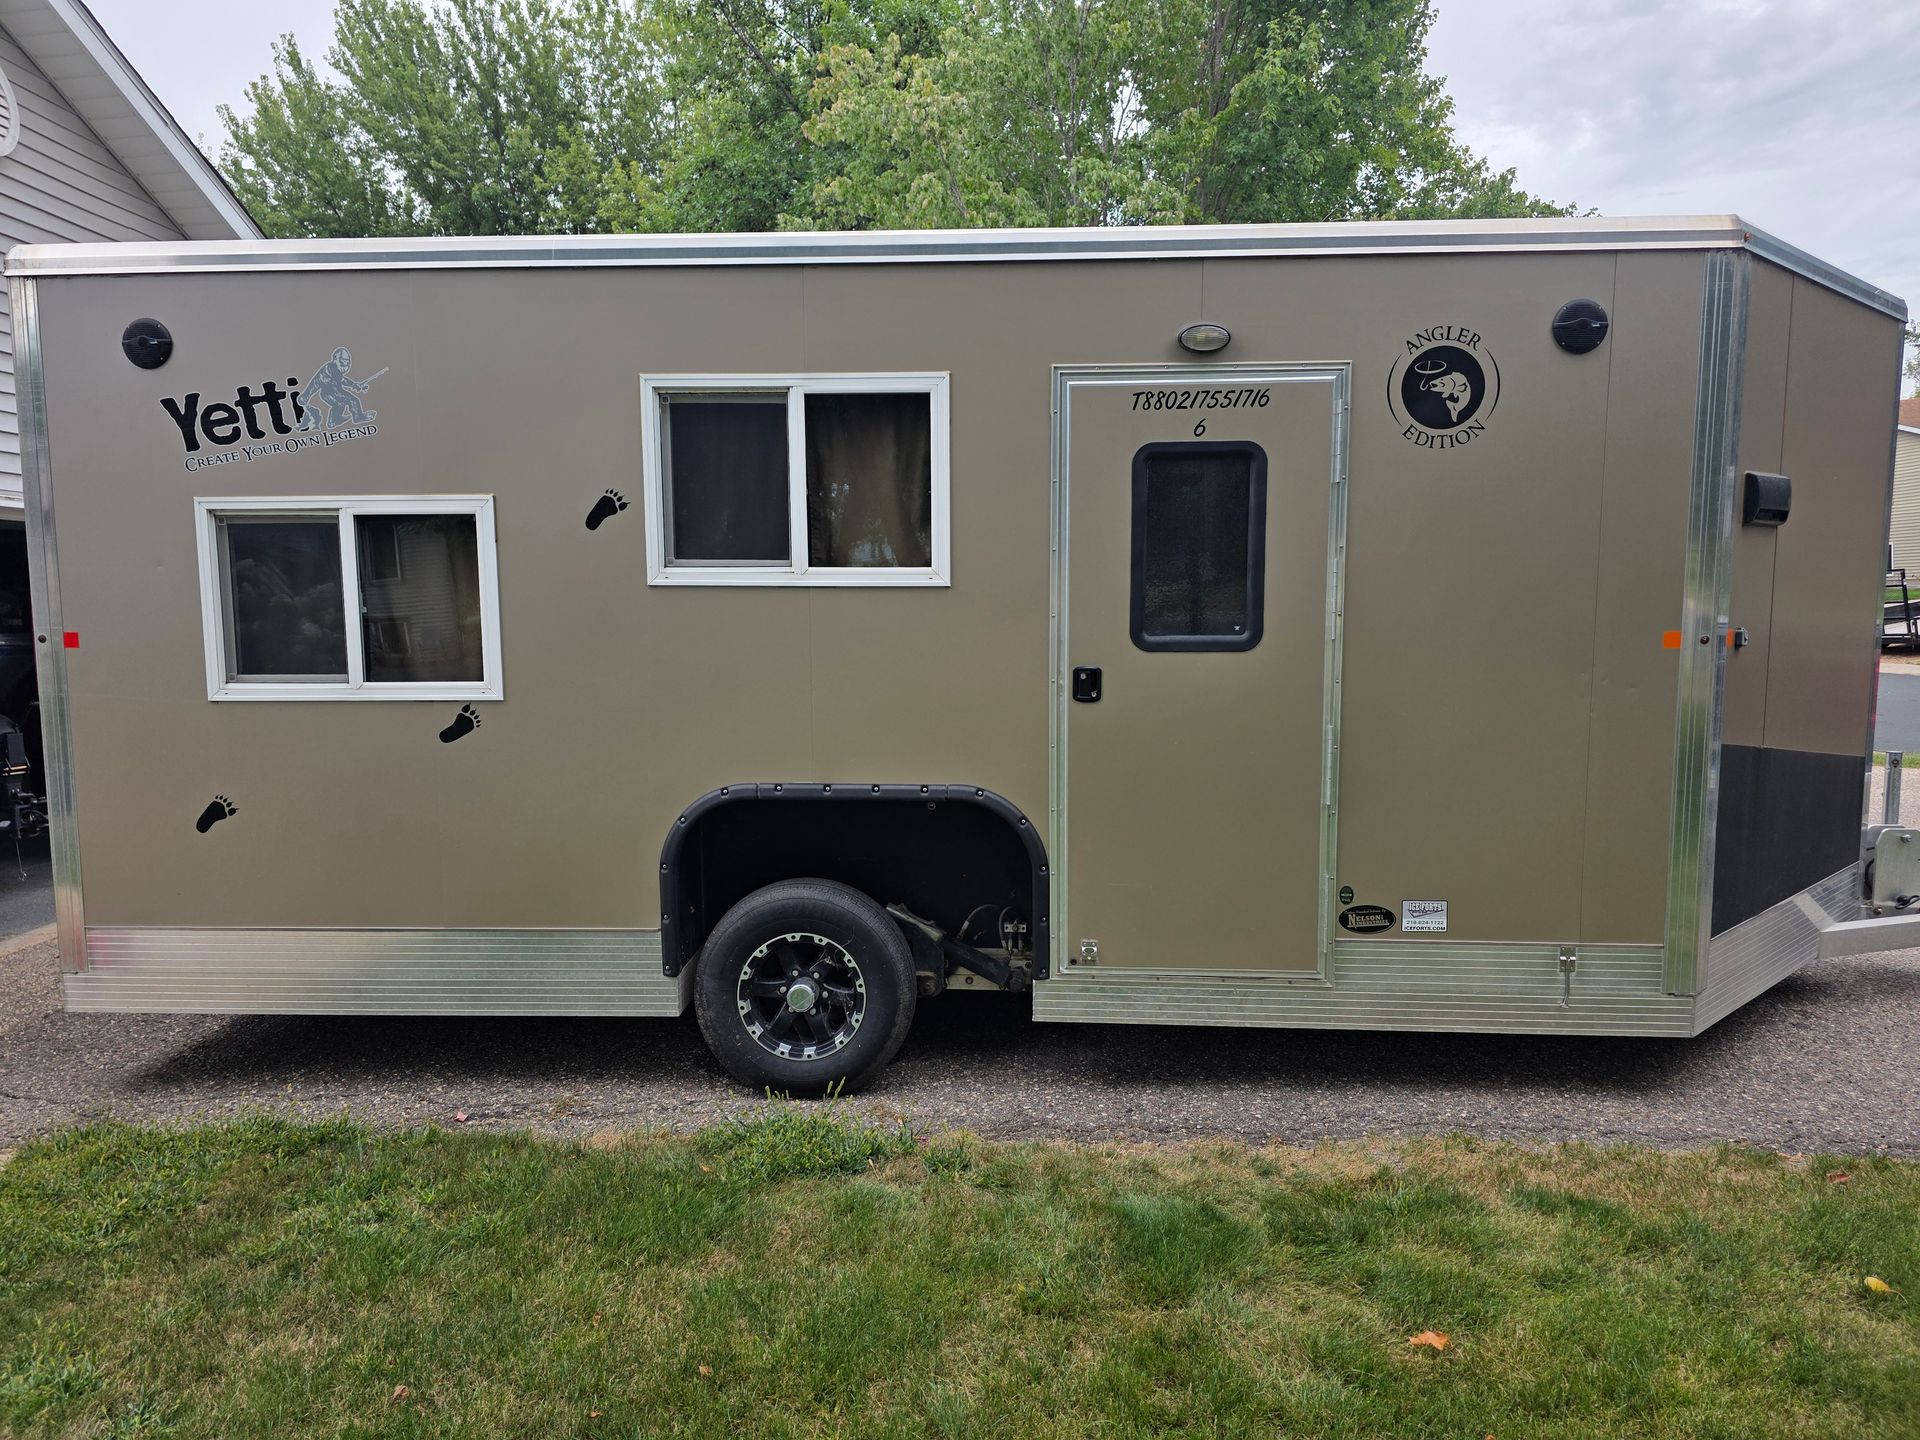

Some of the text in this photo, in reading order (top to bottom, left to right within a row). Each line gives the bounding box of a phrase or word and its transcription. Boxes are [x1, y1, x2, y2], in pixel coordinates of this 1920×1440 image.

[1405, 325, 1482, 355] ANGLER
[1132, 388, 1271, 411] T880217551716
[159, 377, 310, 453] Yetti
[1193, 418, 1207, 437] 6
[184, 425, 377, 472] CREATE YOUR OWN LEGEND
[1402, 418, 1486, 449] EDITION
[1408, 902, 1443, 911] ICE FORTS
